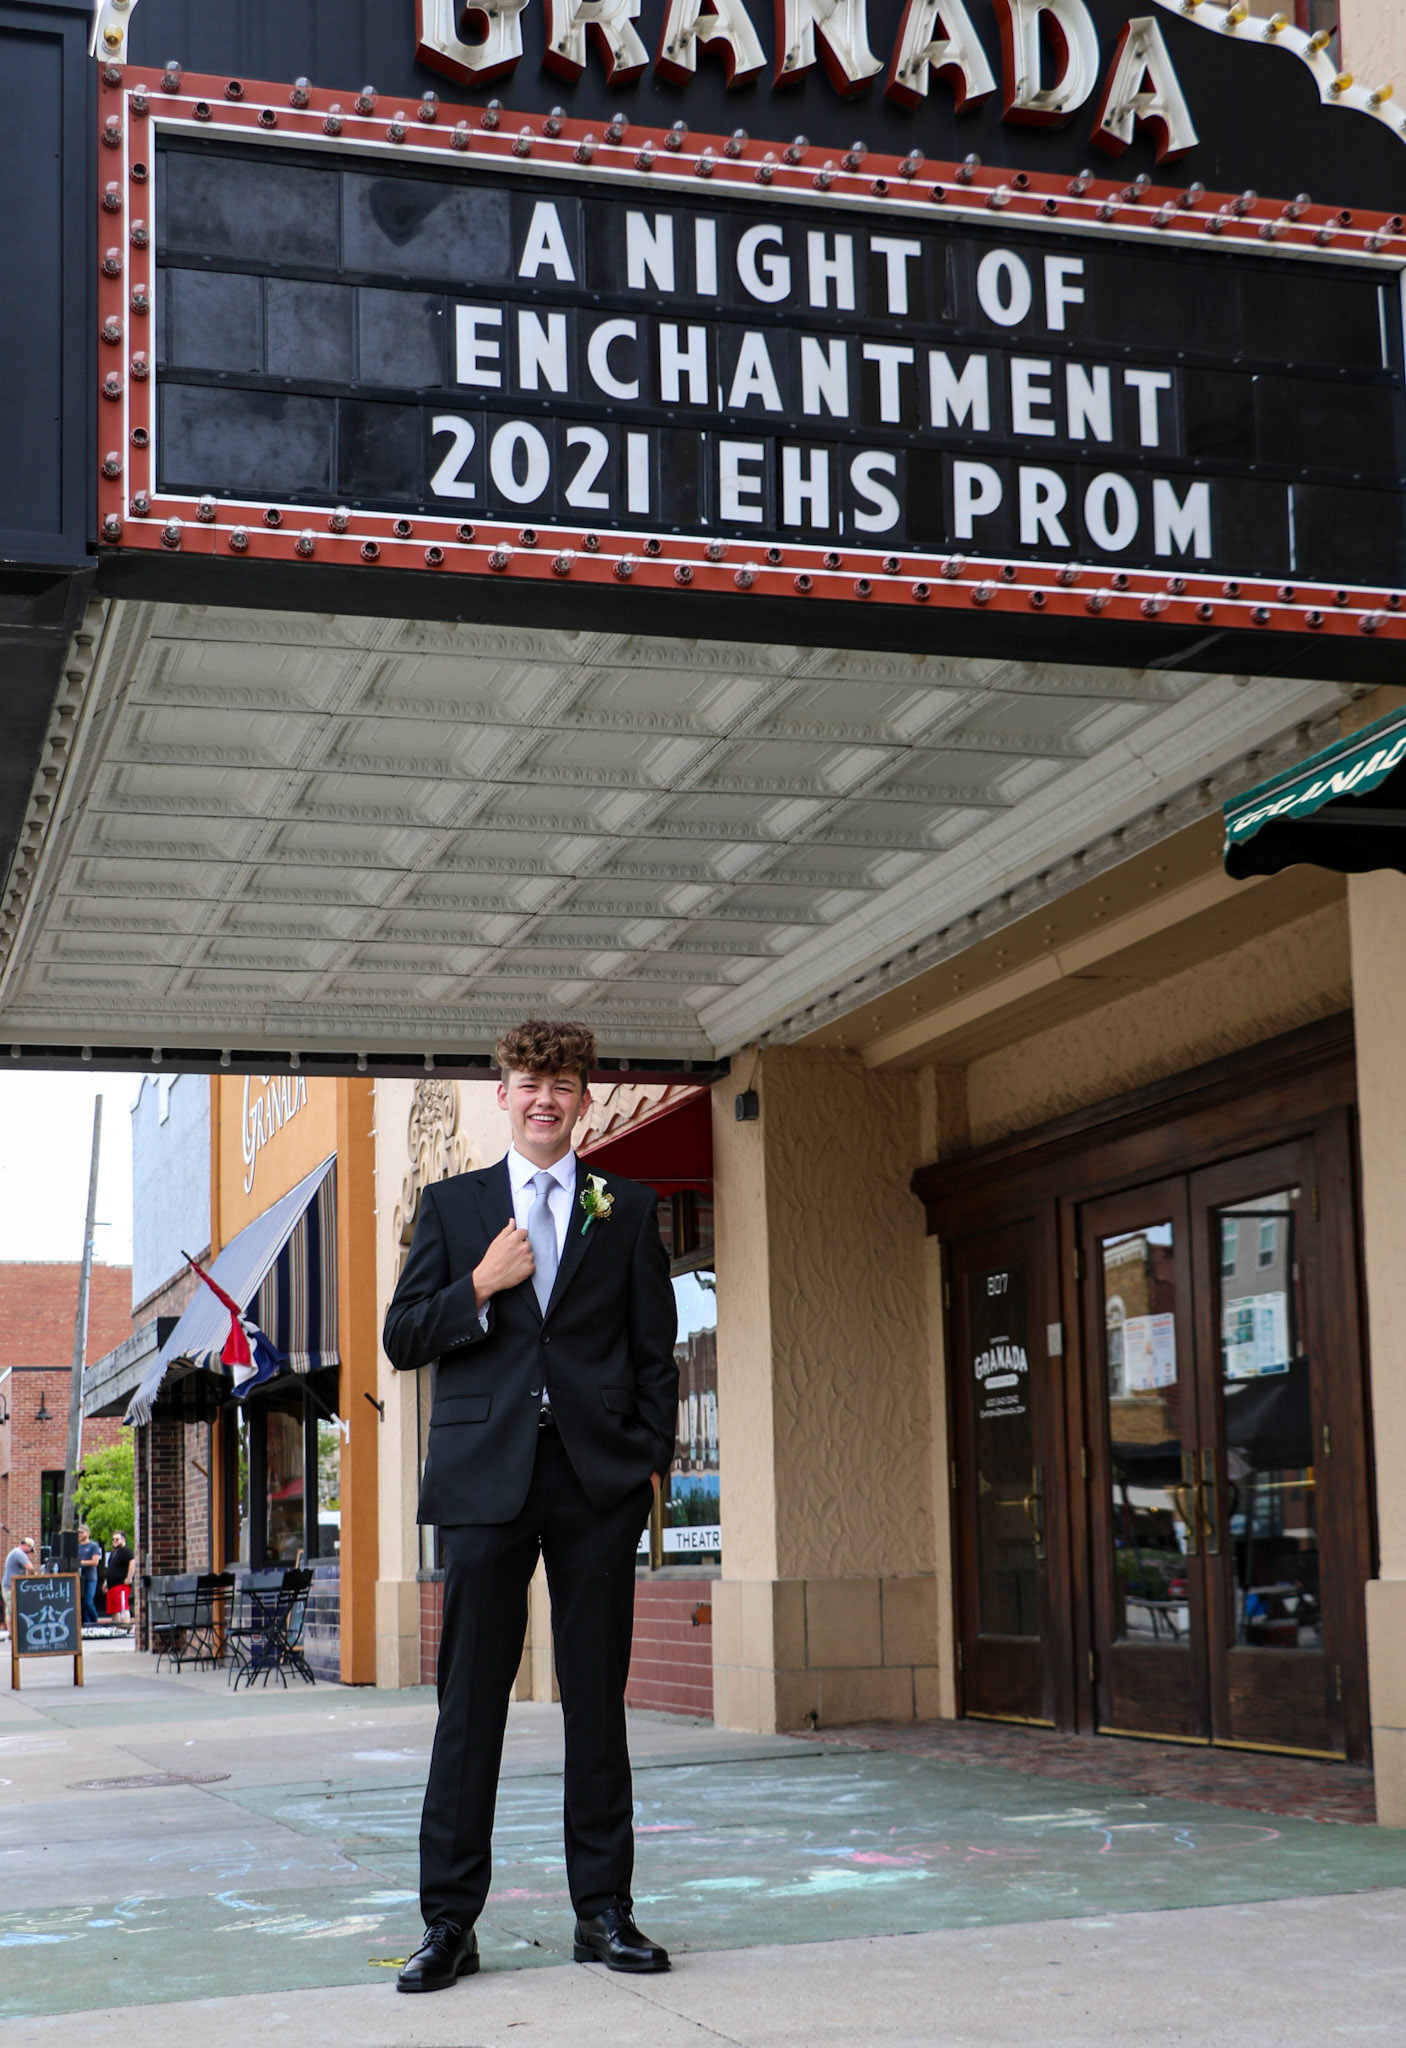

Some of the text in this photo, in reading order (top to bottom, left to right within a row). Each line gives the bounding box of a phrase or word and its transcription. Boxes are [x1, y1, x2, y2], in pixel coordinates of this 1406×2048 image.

[416, 0, 1199, 164] GRANADA
[519, 202, 1084, 331] A NIGHT OF
[455, 304, 1171, 447] ENCHANTMENT
[430, 415, 1212, 560] 2021 EHS PROM
[987, 1273, 1008, 1296] 807
[974, 1345, 1029, 1380] GRANADA
[20, 1578, 54, 1593] Good
[39, 1581, 70, 1603] Luck!
